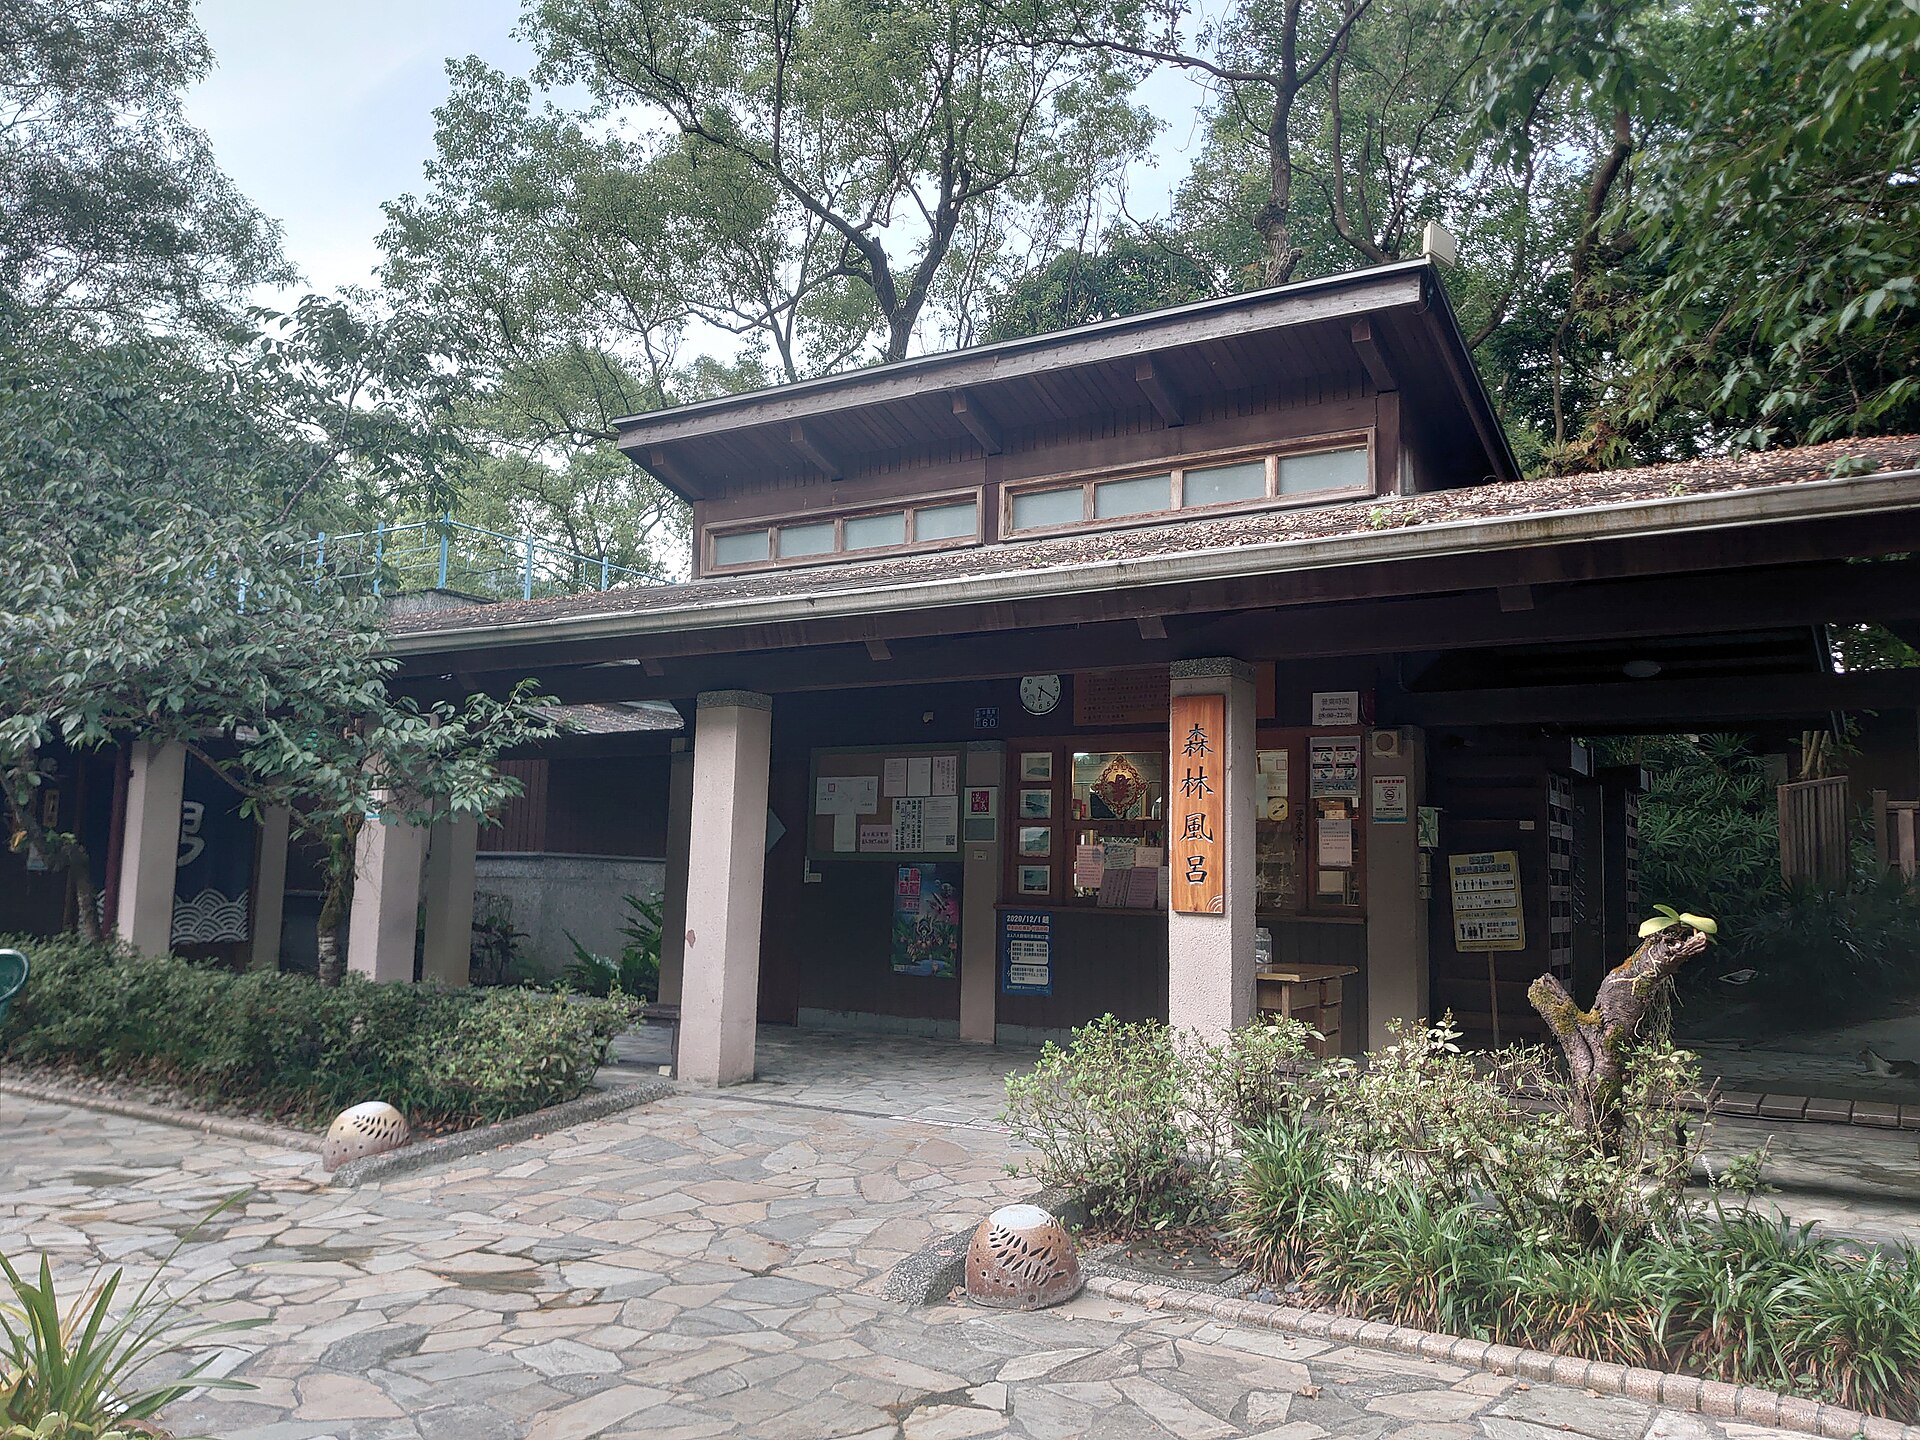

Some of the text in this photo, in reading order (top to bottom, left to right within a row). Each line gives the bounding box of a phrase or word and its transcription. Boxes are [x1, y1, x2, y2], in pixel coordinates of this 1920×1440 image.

[982, 718, 996, 728] 60
[1179, 723, 1214, 885] 森林風呂
[1006, 914, 1041, 924] 2020/12/1
